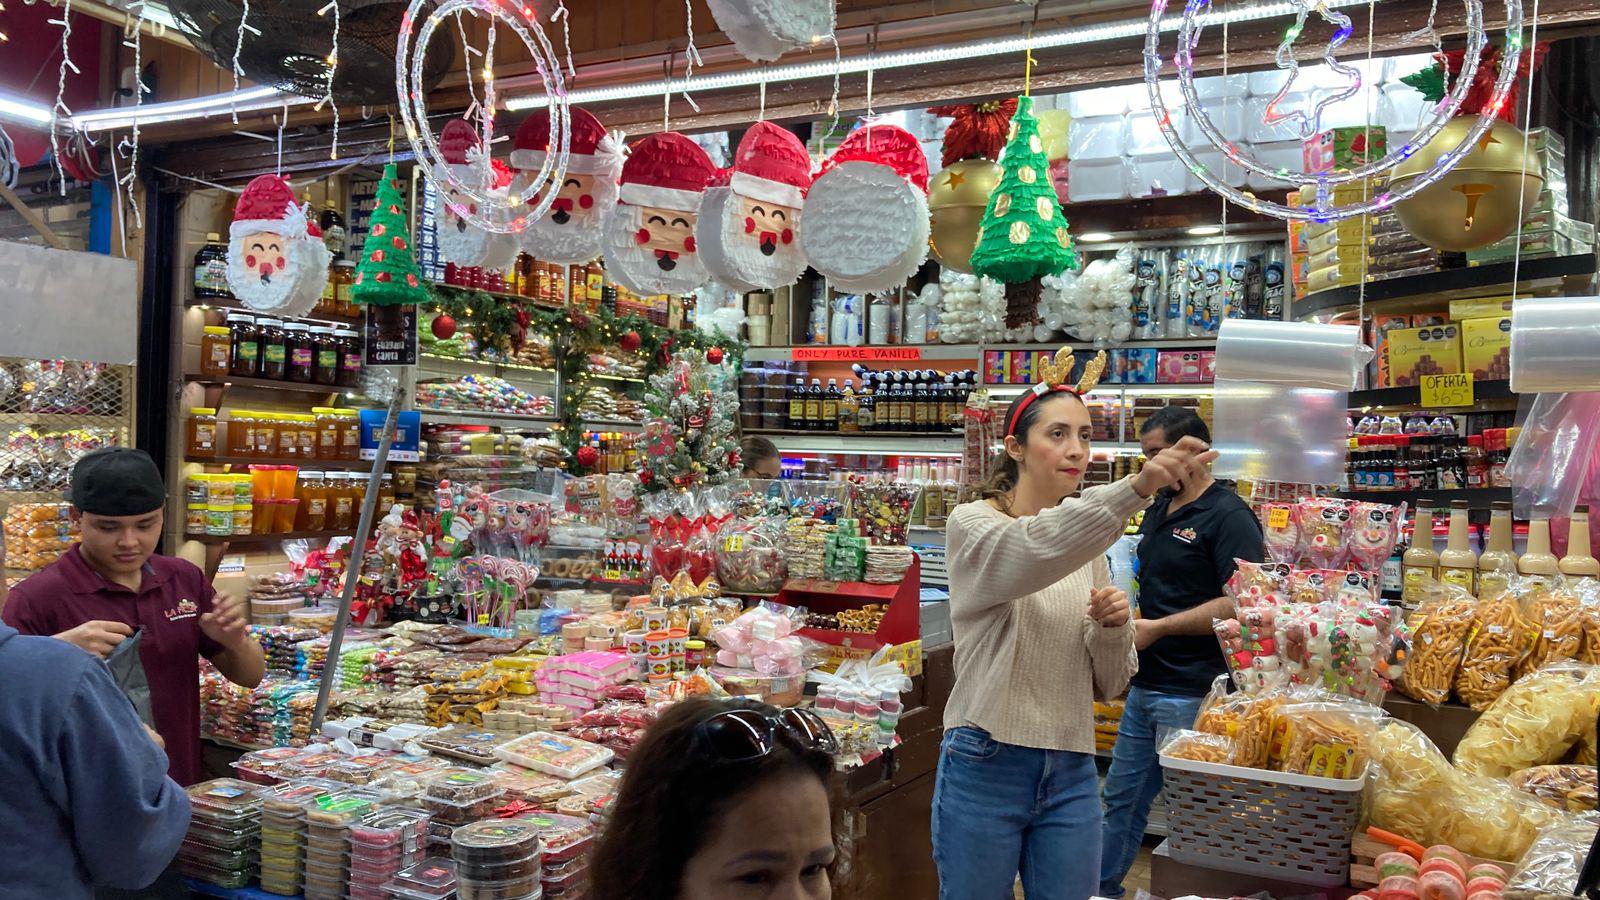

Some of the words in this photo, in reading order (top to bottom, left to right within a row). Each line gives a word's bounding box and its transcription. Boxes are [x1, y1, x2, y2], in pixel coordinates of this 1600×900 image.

[797, 350, 828, 358] ONLY
[837, 350, 867, 359] PURE
[874, 349, 921, 359] VANILLA
[1426, 374, 1468, 389] OFERTA
